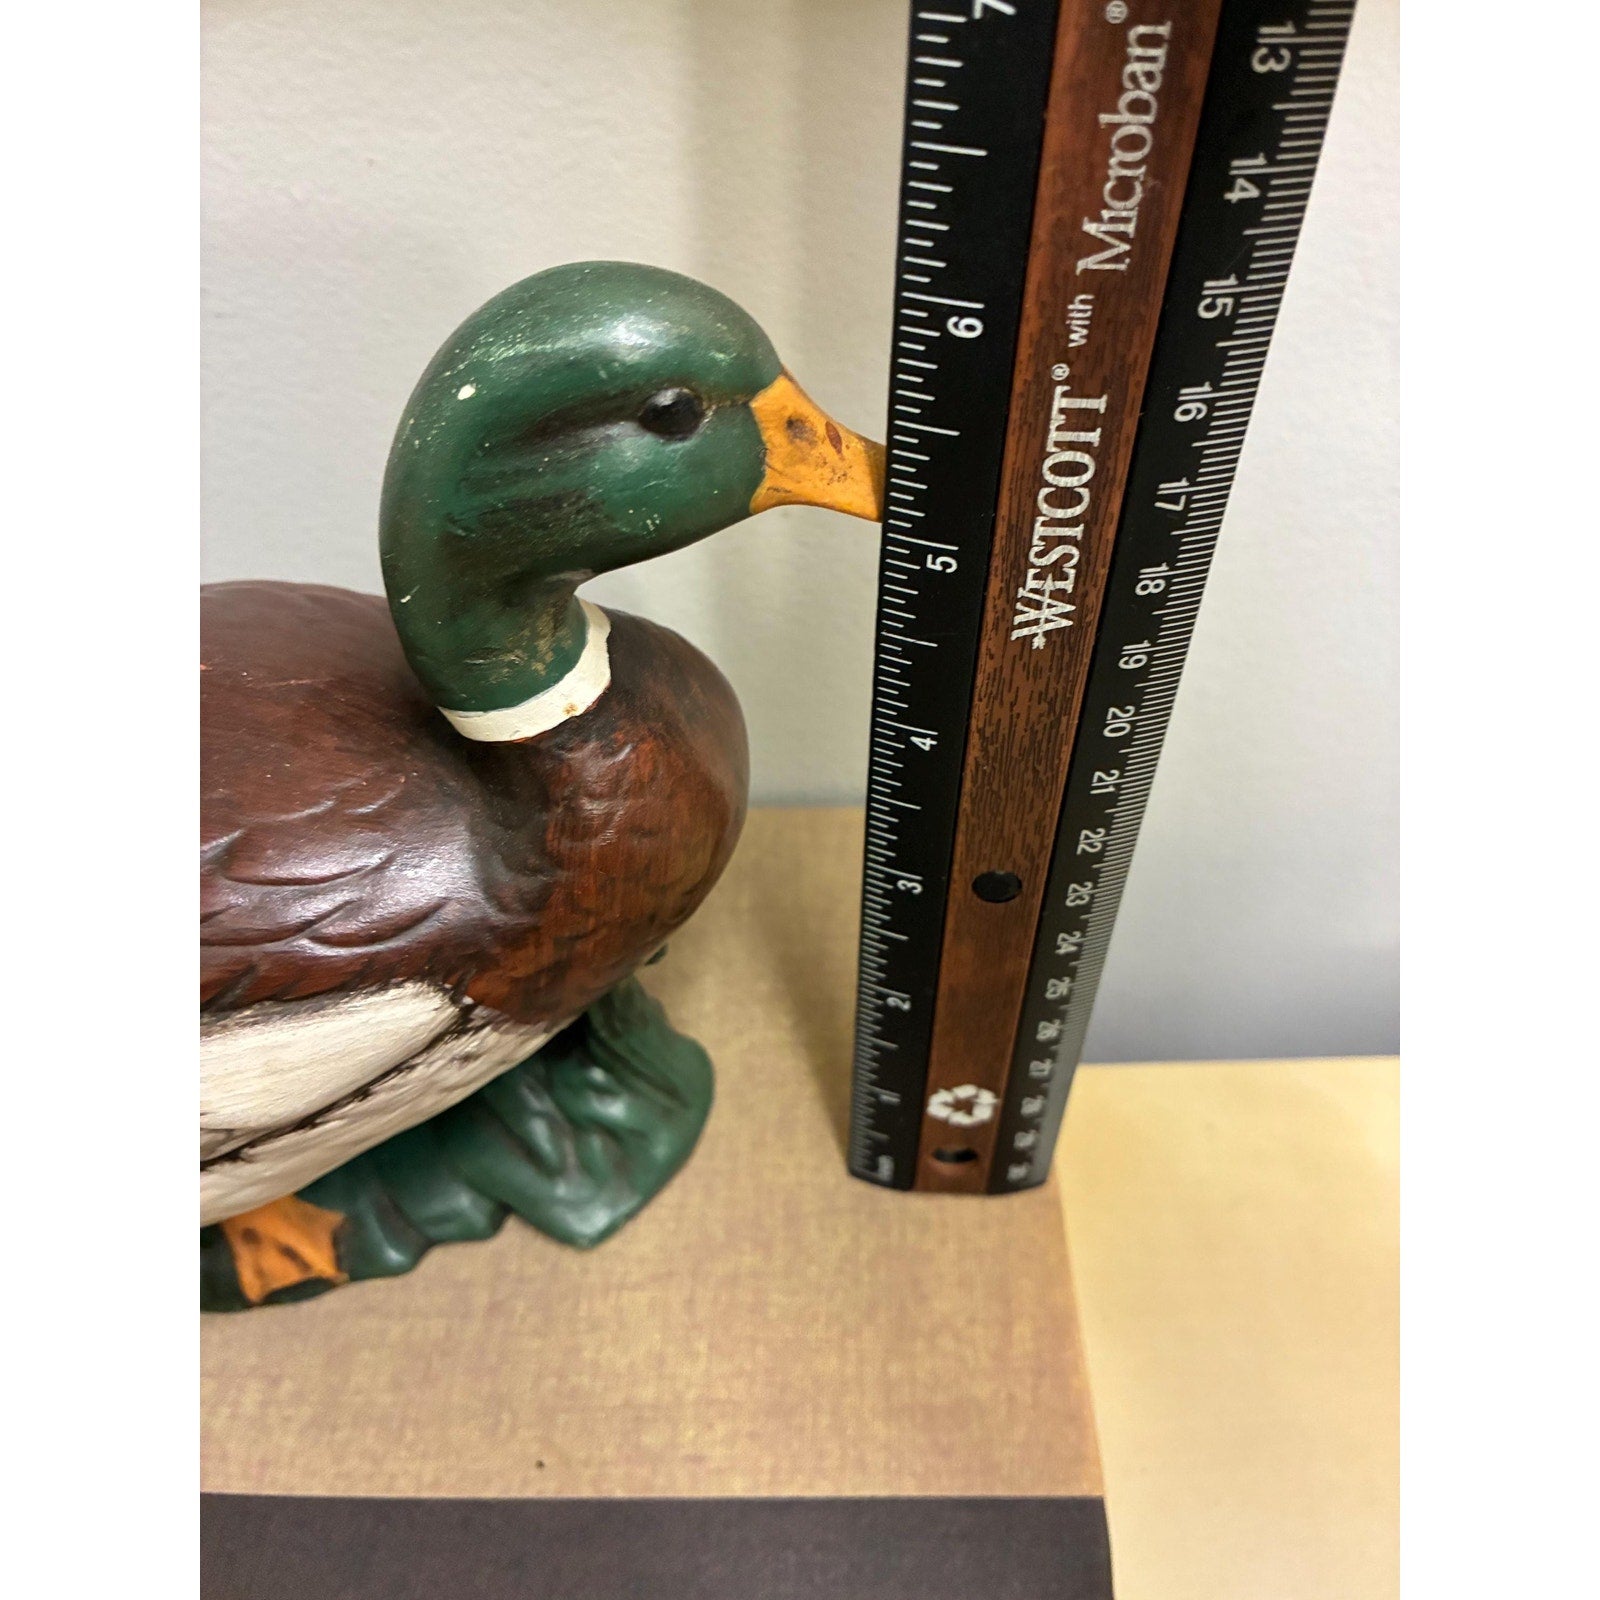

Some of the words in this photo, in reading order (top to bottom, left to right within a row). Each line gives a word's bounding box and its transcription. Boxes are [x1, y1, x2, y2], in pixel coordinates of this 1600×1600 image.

[1251, 20, 1295, 74] 13
[1224, 152, 1267, 204] 14
[1197, 273, 1239, 320] 15
[946, 315, 984, 339] 6
[1066, 294, 1095, 348] with
[1173, 381, 1213, 423] 16
[1155, 477, 1190, 512] 17
[926, 553, 958, 573] 5
[1135, 562, 1168, 596] 18
[1118, 639, 1151, 670] 19
[1103, 705, 1135, 738] 20
[909, 736, 938, 751] 4
[1090, 768, 1120, 795] 21
[1076, 827, 1105, 855] 22
[897, 878, 923, 895] 3
[1064, 881, 1093, 907] 23
[1055, 931, 1081, 955] 24
[886, 996, 911, 1012] 2
